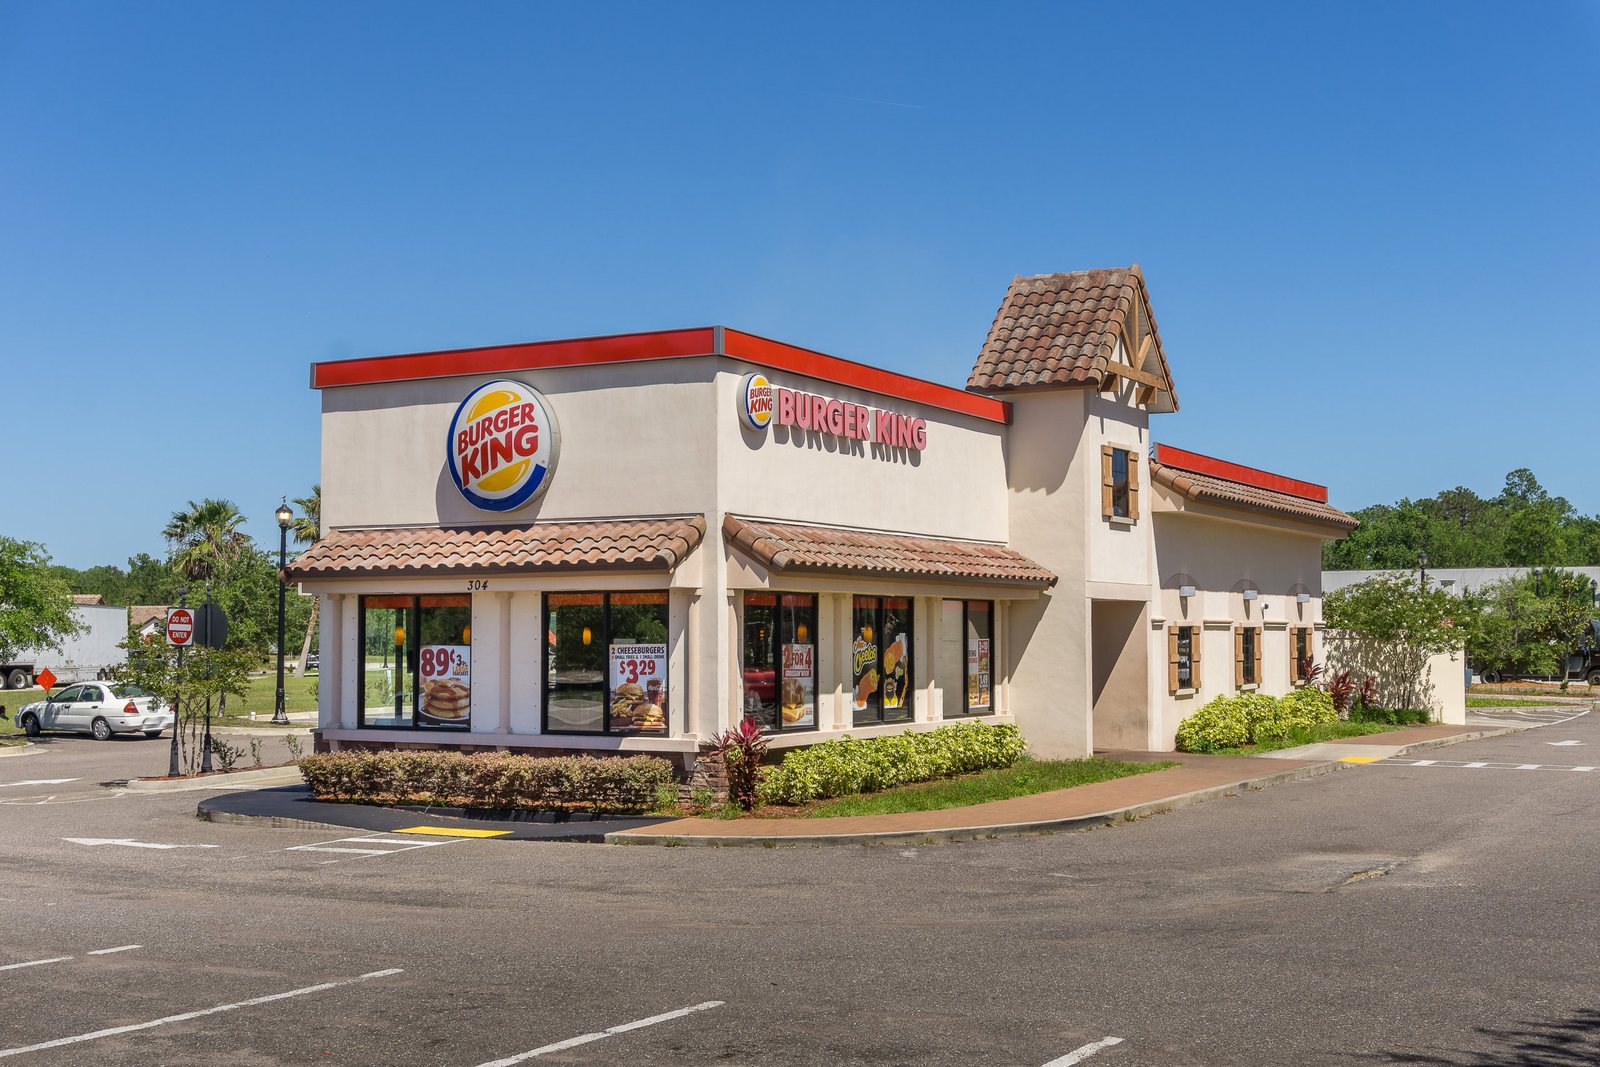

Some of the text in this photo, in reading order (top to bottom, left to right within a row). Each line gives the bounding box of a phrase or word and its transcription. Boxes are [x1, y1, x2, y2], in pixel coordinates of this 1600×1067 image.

[750, 398, 772, 414] KING
[458, 402, 535, 456] BURGER
[778, 388, 927, 451] BURGER KING
[461, 424, 539, 488] KING
[467, 580, 488, 590] 304
[617, 646, 665, 655] CHEESEBURGERS
[783, 646, 812, 669] 2 FOR 4
